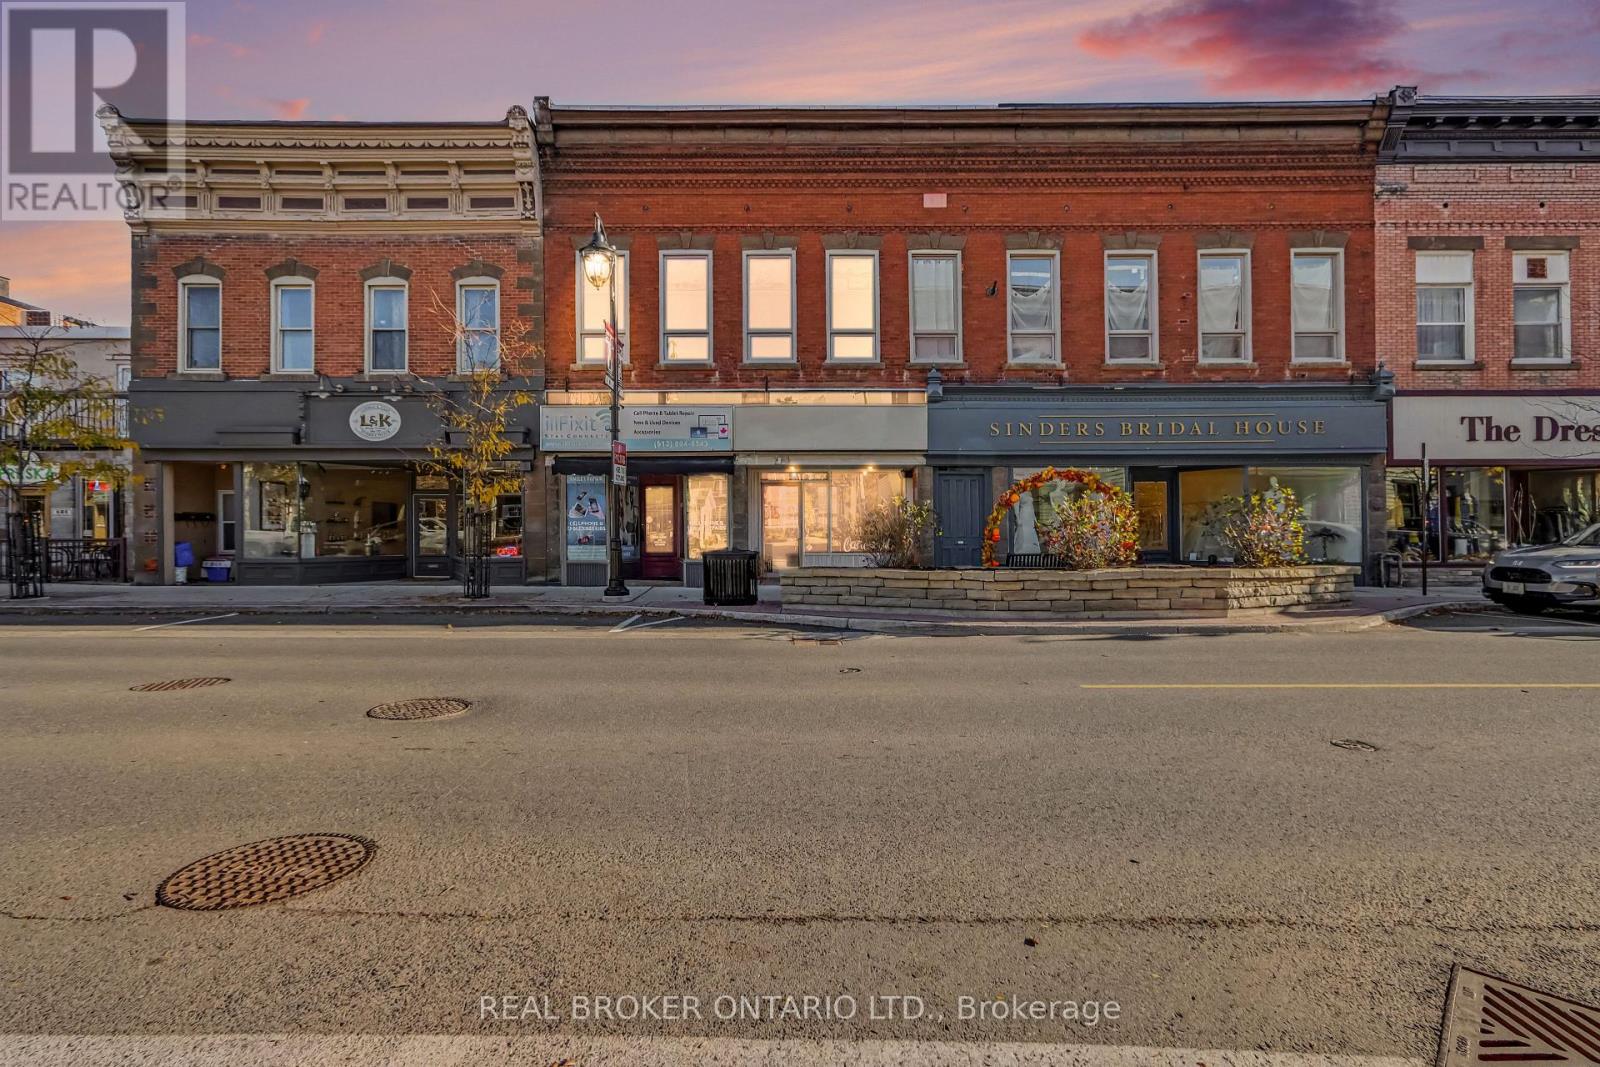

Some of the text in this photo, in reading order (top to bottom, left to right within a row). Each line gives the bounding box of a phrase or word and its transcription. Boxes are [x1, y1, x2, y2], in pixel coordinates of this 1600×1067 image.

[360, 413, 392, 428] L&K
[989, 419, 1328, 437] SINDERS BRIDAL HOUSE
[1460, 415, 1521, 442] The
